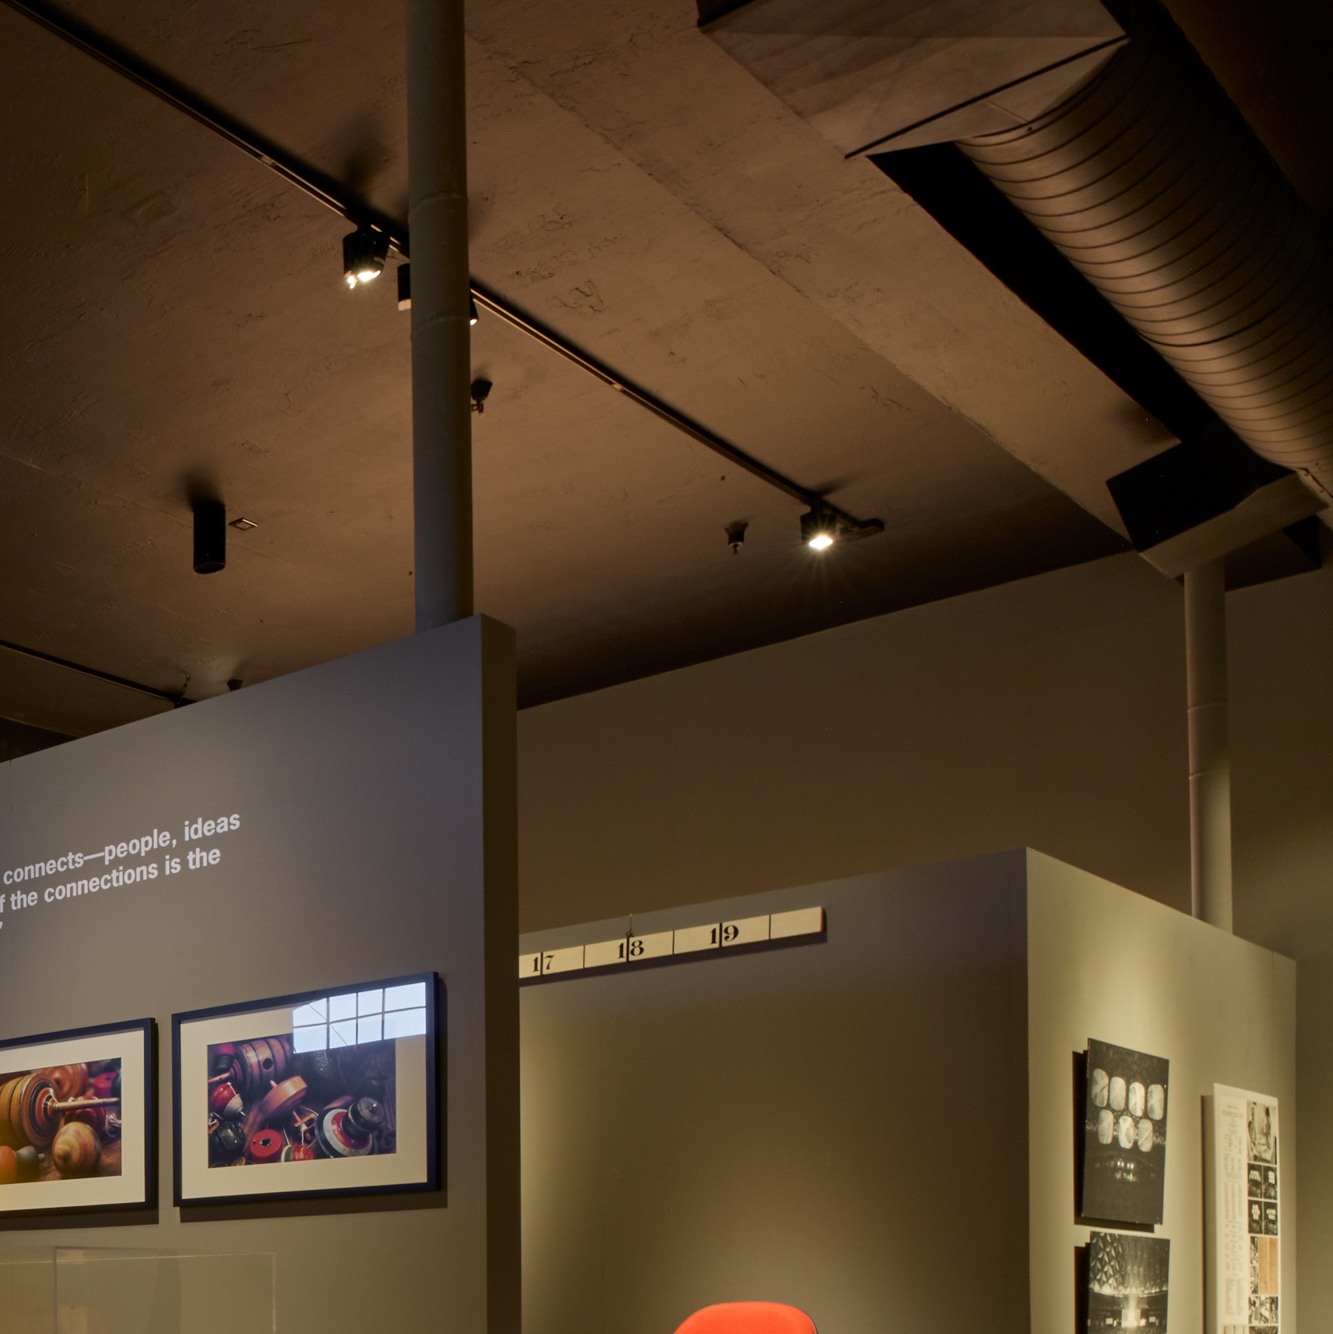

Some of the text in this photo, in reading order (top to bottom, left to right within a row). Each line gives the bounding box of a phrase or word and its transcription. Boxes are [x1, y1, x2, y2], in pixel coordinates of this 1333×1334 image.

[184, 812, 240, 841] ideas
[11, 889, 38, 911] the
[44, 861, 158, 902] connections
[164, 854, 181, 876] is
[188, 847, 220, 870] the
